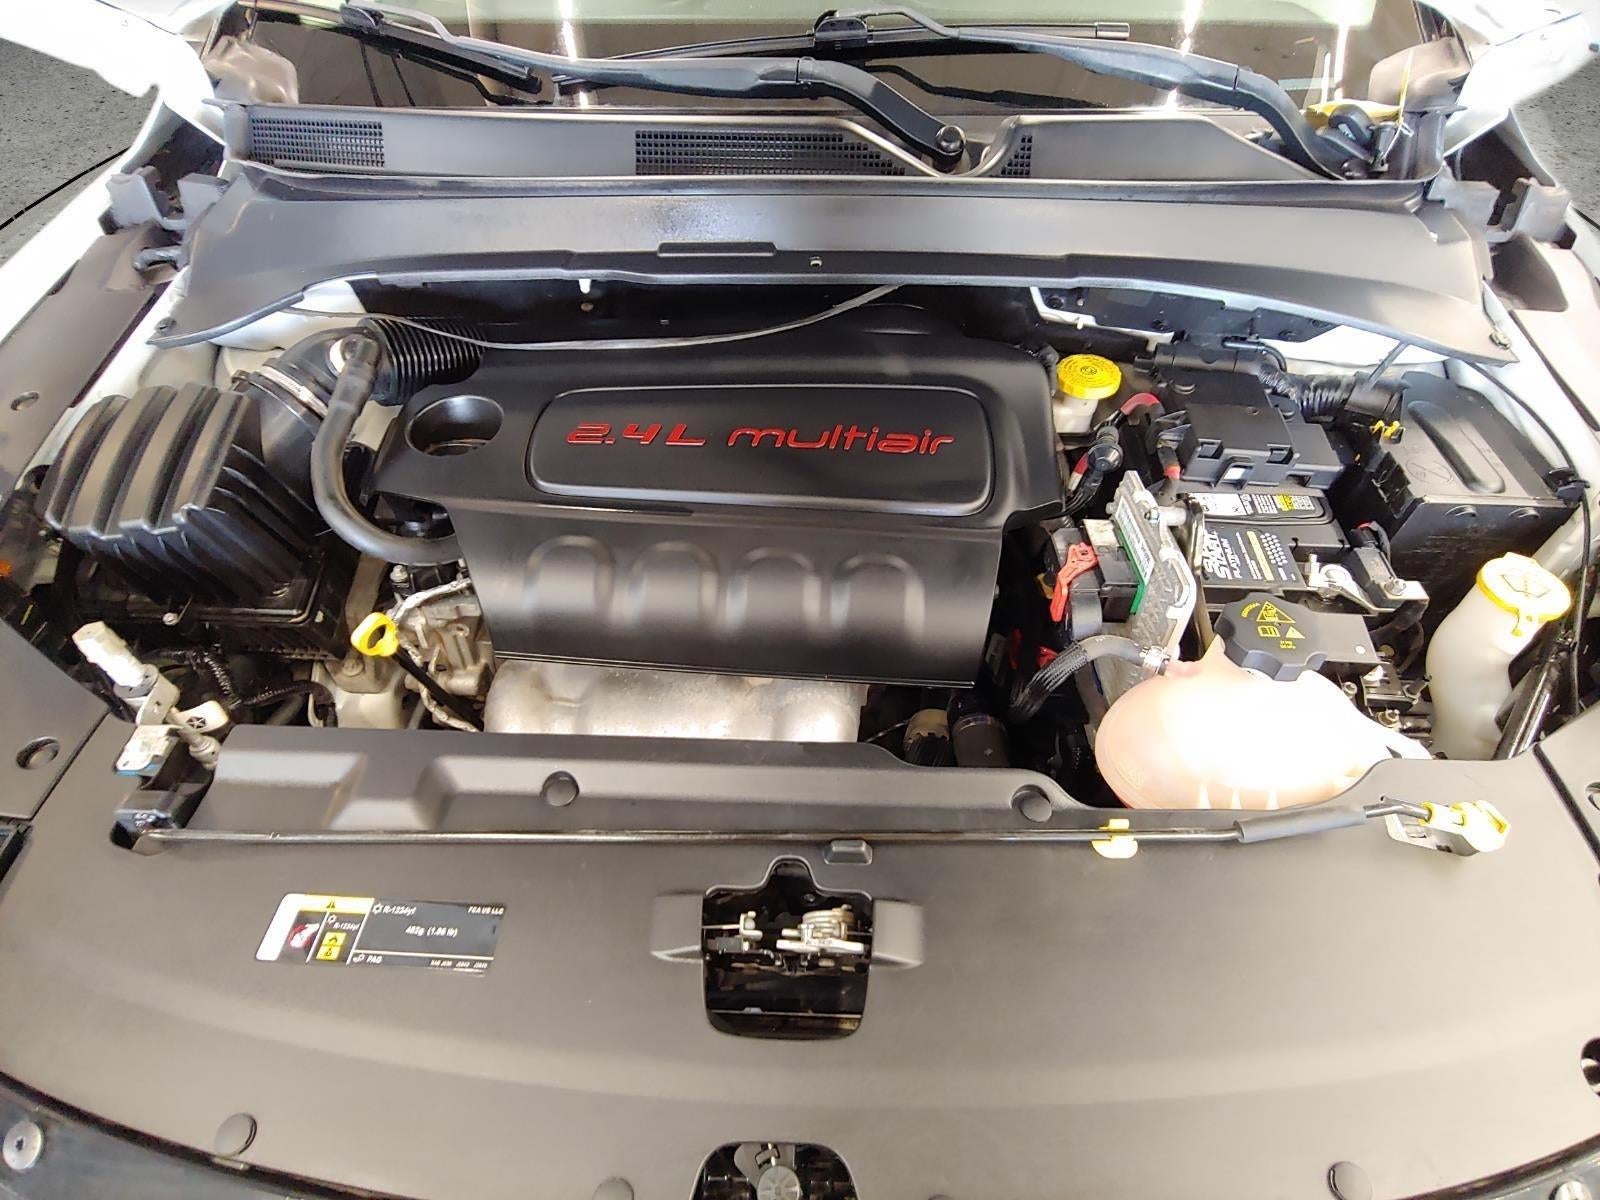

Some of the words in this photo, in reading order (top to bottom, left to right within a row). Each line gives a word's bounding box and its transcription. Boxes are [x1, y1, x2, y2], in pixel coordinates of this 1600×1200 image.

[727, 424, 954, 455] multiair
[382, 905, 417, 917] R-1234yf
[467, 905, 481, 914] FCA
